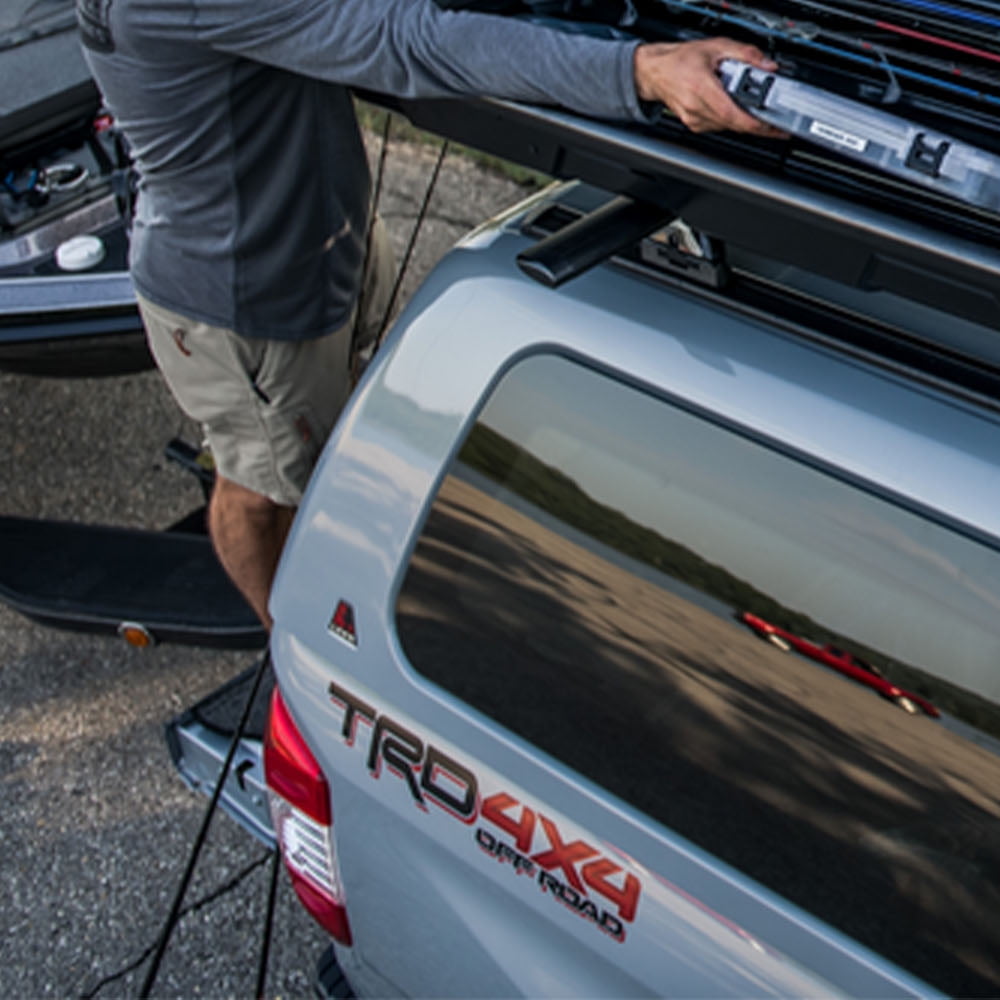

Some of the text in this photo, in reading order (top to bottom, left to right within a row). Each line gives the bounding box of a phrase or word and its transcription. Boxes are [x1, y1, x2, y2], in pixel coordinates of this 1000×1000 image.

[328, 681, 481, 825] TRD
[475, 828, 627, 944] OFF ROAD
